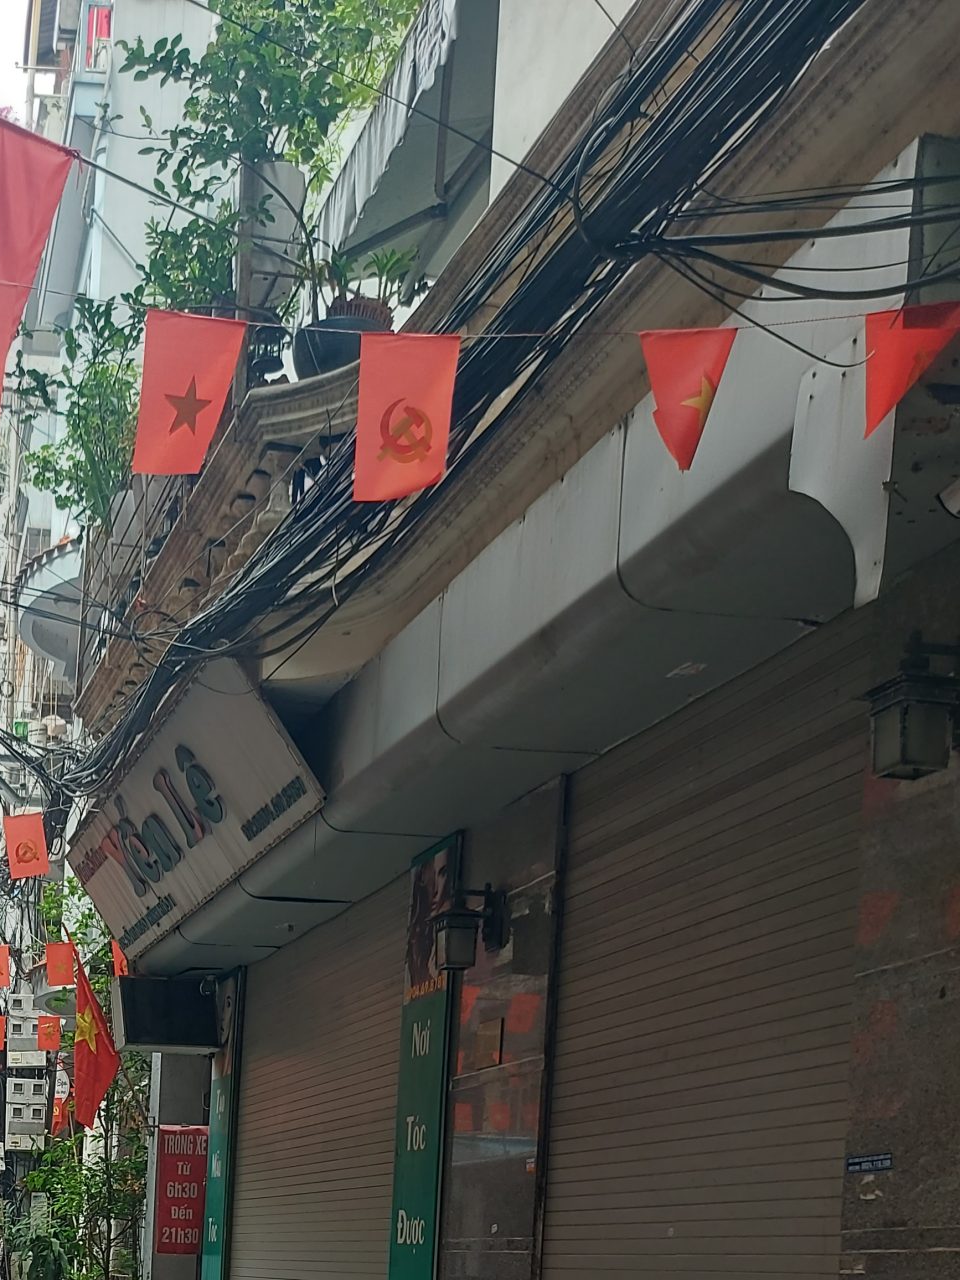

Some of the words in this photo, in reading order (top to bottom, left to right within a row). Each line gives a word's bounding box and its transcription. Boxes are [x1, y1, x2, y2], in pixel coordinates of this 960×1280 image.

[101, 793, 184, 897] Yến
[153, 744, 227, 849] Lê
[411, 1019, 431, 1057] Nơi
[406, 1115, 426, 1151] Tóc
[195, 1135, 208, 1155] XE
[177, 1161, 192, 1175] Từ
[166, 1181, 198, 1199] 6h30
[171, 1203, 193, 1220] Đến
[161, 1226, 199, 1244] 21h30
[208, 1217, 218, 1242] Tóc
[397, 1209, 425, 1254] Được
